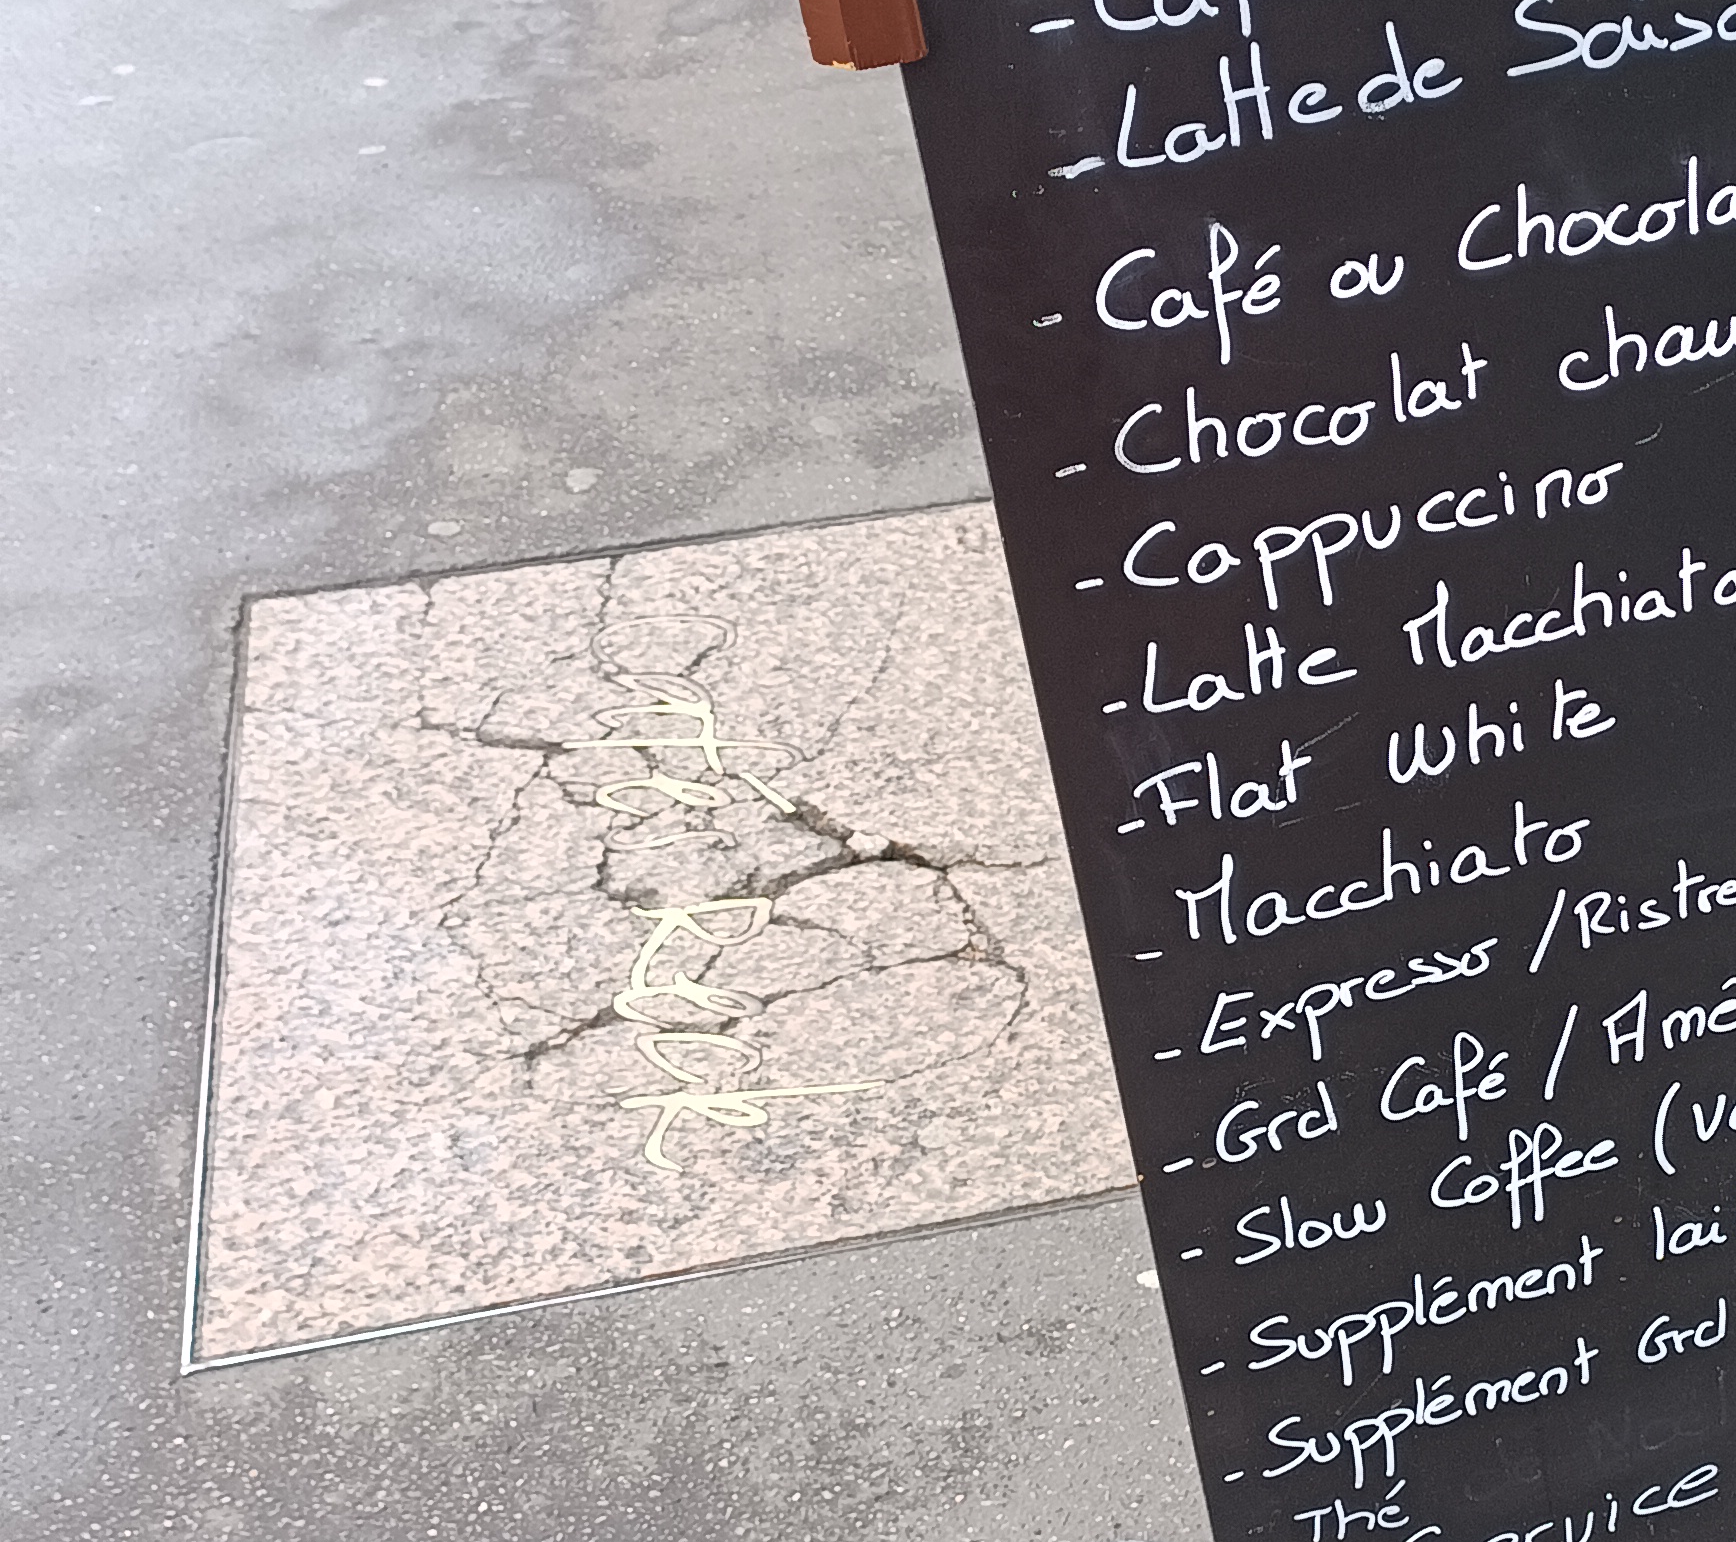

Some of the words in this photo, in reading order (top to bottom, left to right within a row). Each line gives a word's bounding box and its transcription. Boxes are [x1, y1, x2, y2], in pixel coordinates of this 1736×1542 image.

[1115, 40, 1344, 169] Latte
[1356, 20, 1464, 115] de
[1094, 221, 1282, 366] Café
[1328, 252, 1406, 300] ou
[1113, 341, 1489, 475] Chocolat
[1122, 461, 1631, 623] Cappuccino
[1141, 621, 1359, 715] Latte
[1132, 738, 1313, 827] Flat
[1387, 677, 1617, 785] White
[1174, 799, 1592, 946] Macchiato
[1199, 936, 1499, 1062] Expresso
[1214, 1079, 1339, 1164] Grd
[1379, 1030, 1510, 1142] Café
[1233, 1194, 1388, 1266] Slow
[1429, 1121, 1620, 1231] Coffee
[1246, 1234, 1605, 1388] Supplément
[1261, 1336, 1600, 1490] Supplément
[1636, 1296, 1728, 1364] Grd
